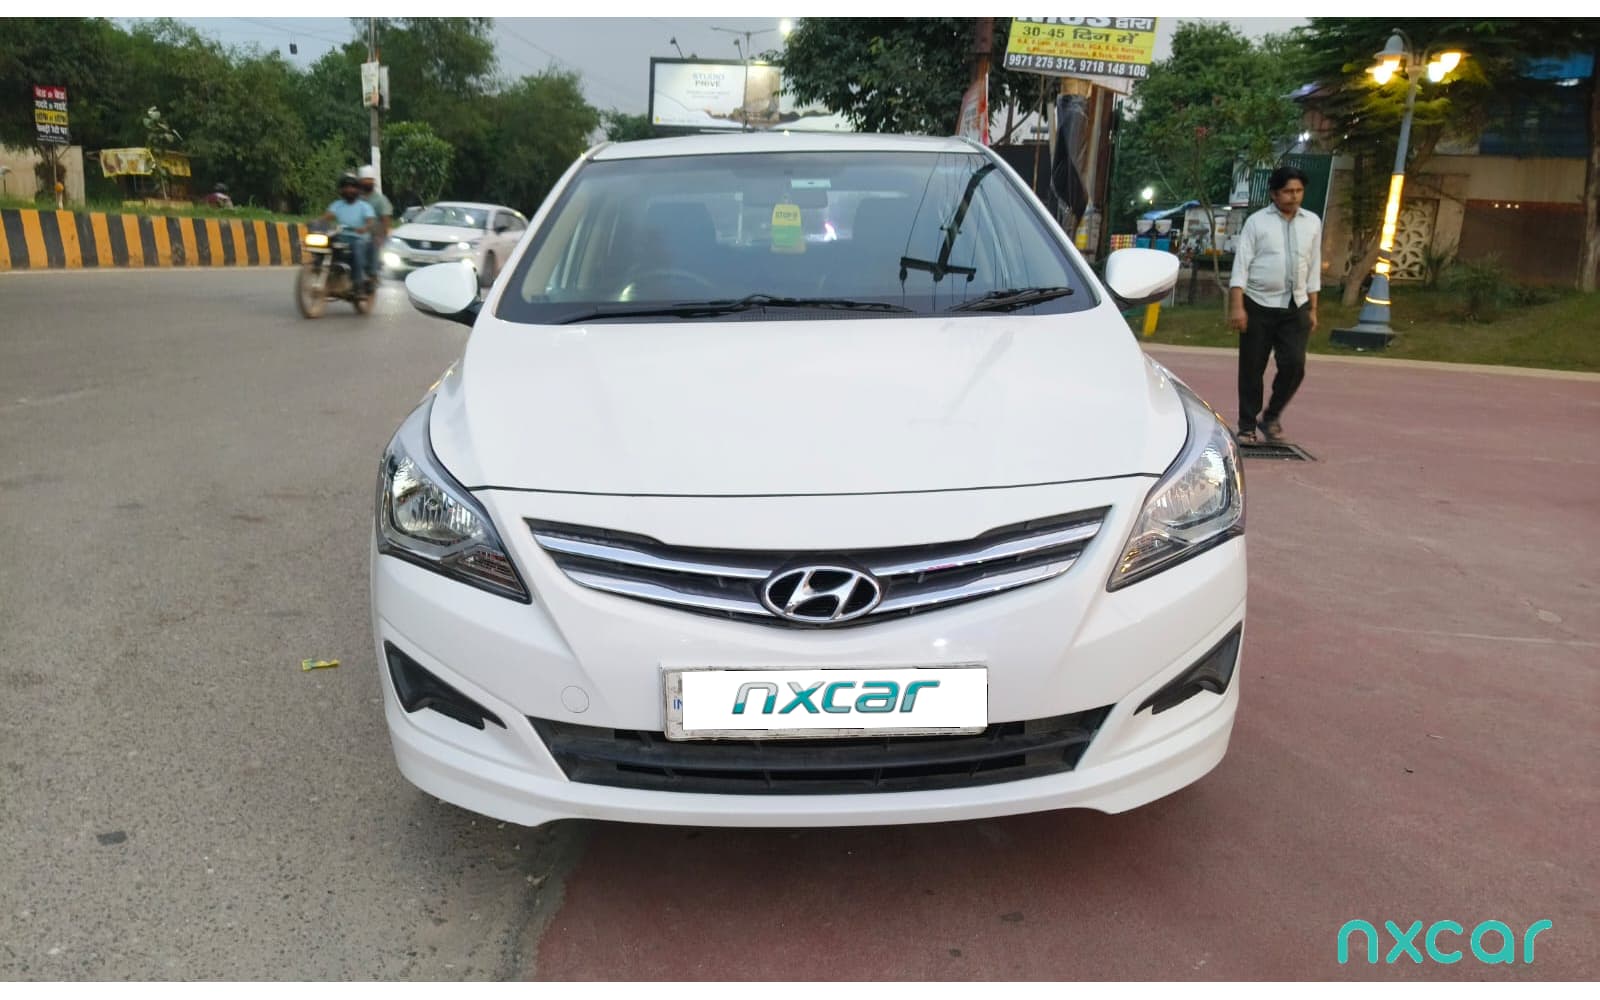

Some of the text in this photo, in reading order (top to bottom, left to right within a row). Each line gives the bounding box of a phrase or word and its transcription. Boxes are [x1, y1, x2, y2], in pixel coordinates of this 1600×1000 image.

[1023, 25, 1065, 39] 30-45
[1072, 27, 1110, 43] दिन
[1117, 32, 1139, 44] में
[1008, 54, 1032, 66] 9971
[1035, 56, 1053, 68] 275
[1056, 58, 1077, 72] 312,
[1080, 60, 1104, 73] 9718
[1107, 62, 1125, 75] 148
